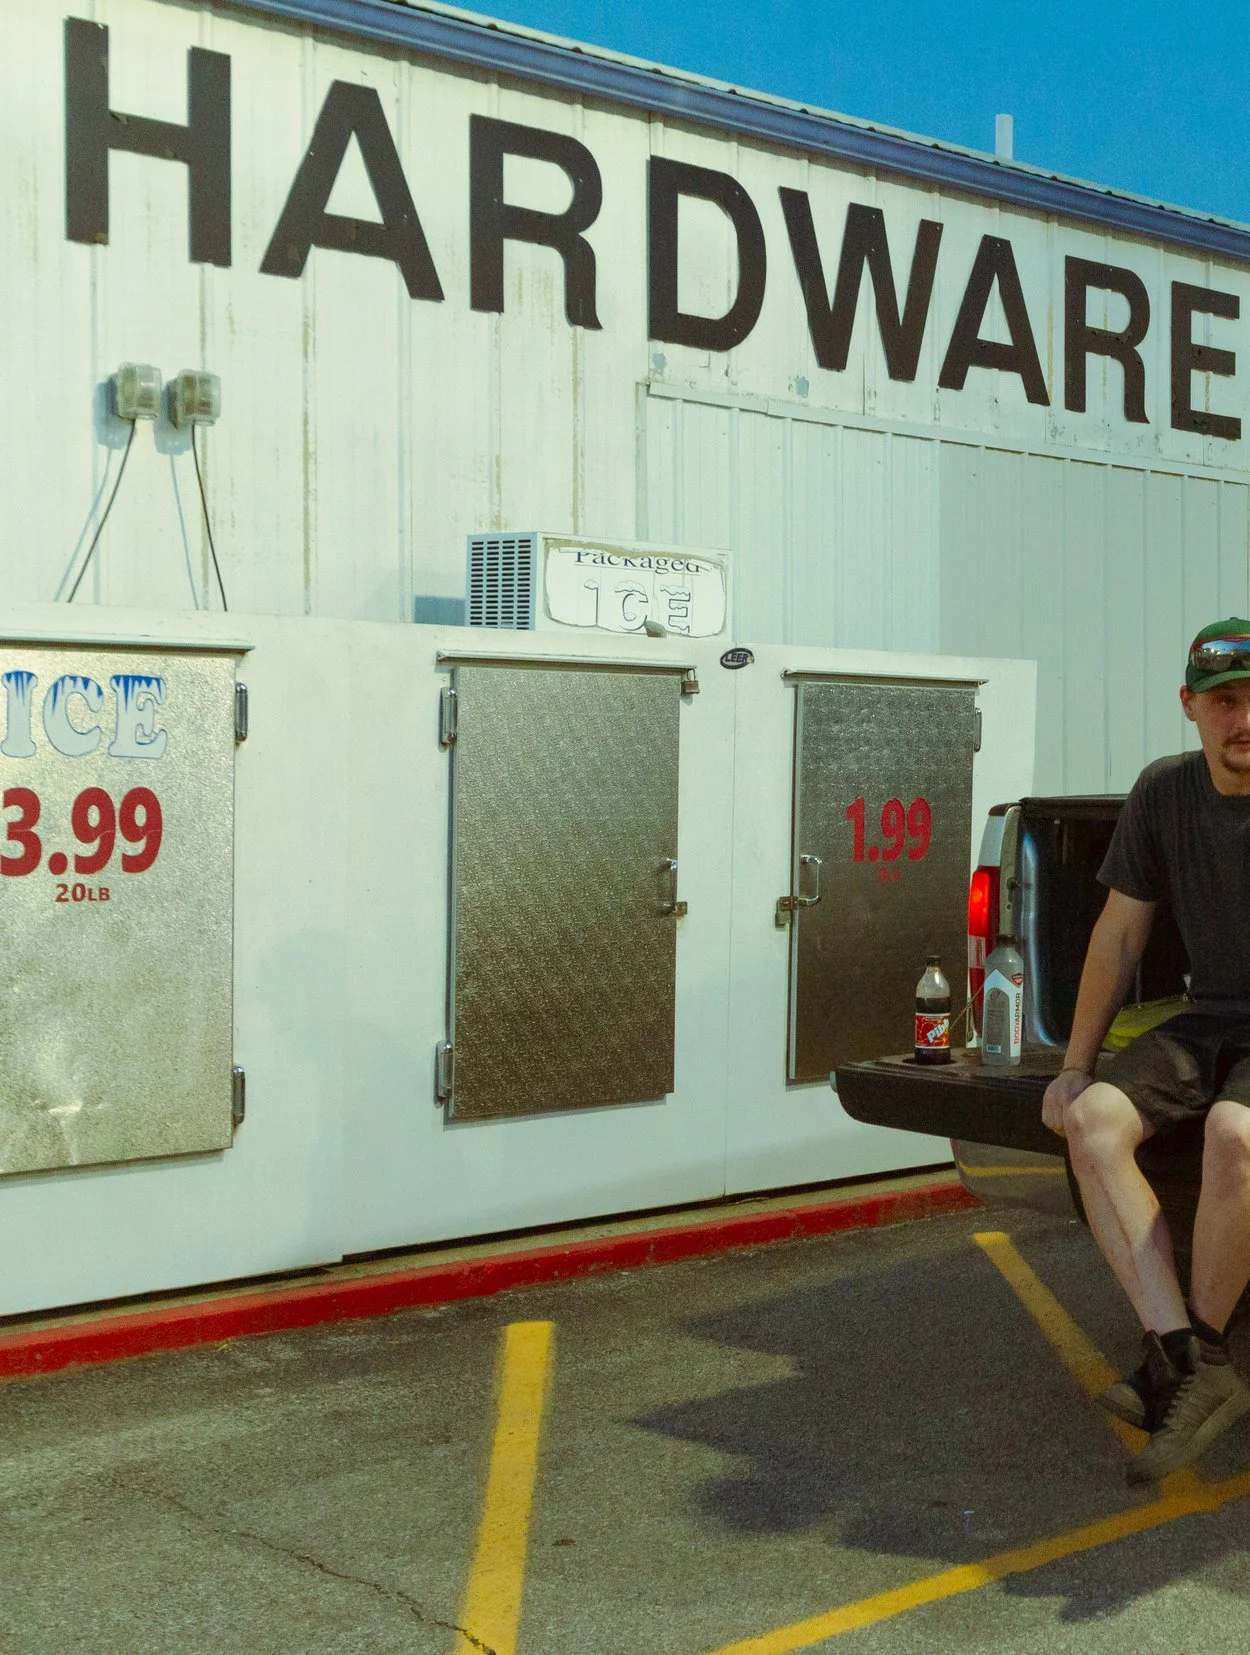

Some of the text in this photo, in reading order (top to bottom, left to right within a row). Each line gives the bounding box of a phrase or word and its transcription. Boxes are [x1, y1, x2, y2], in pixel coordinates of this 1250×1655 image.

[65, 16, 1241, 439] HARDWARE
[1, 671, 167, 759] ICE
[0, 786, 163, 876] 3.99
[845, 796, 932, 863] 1.99
